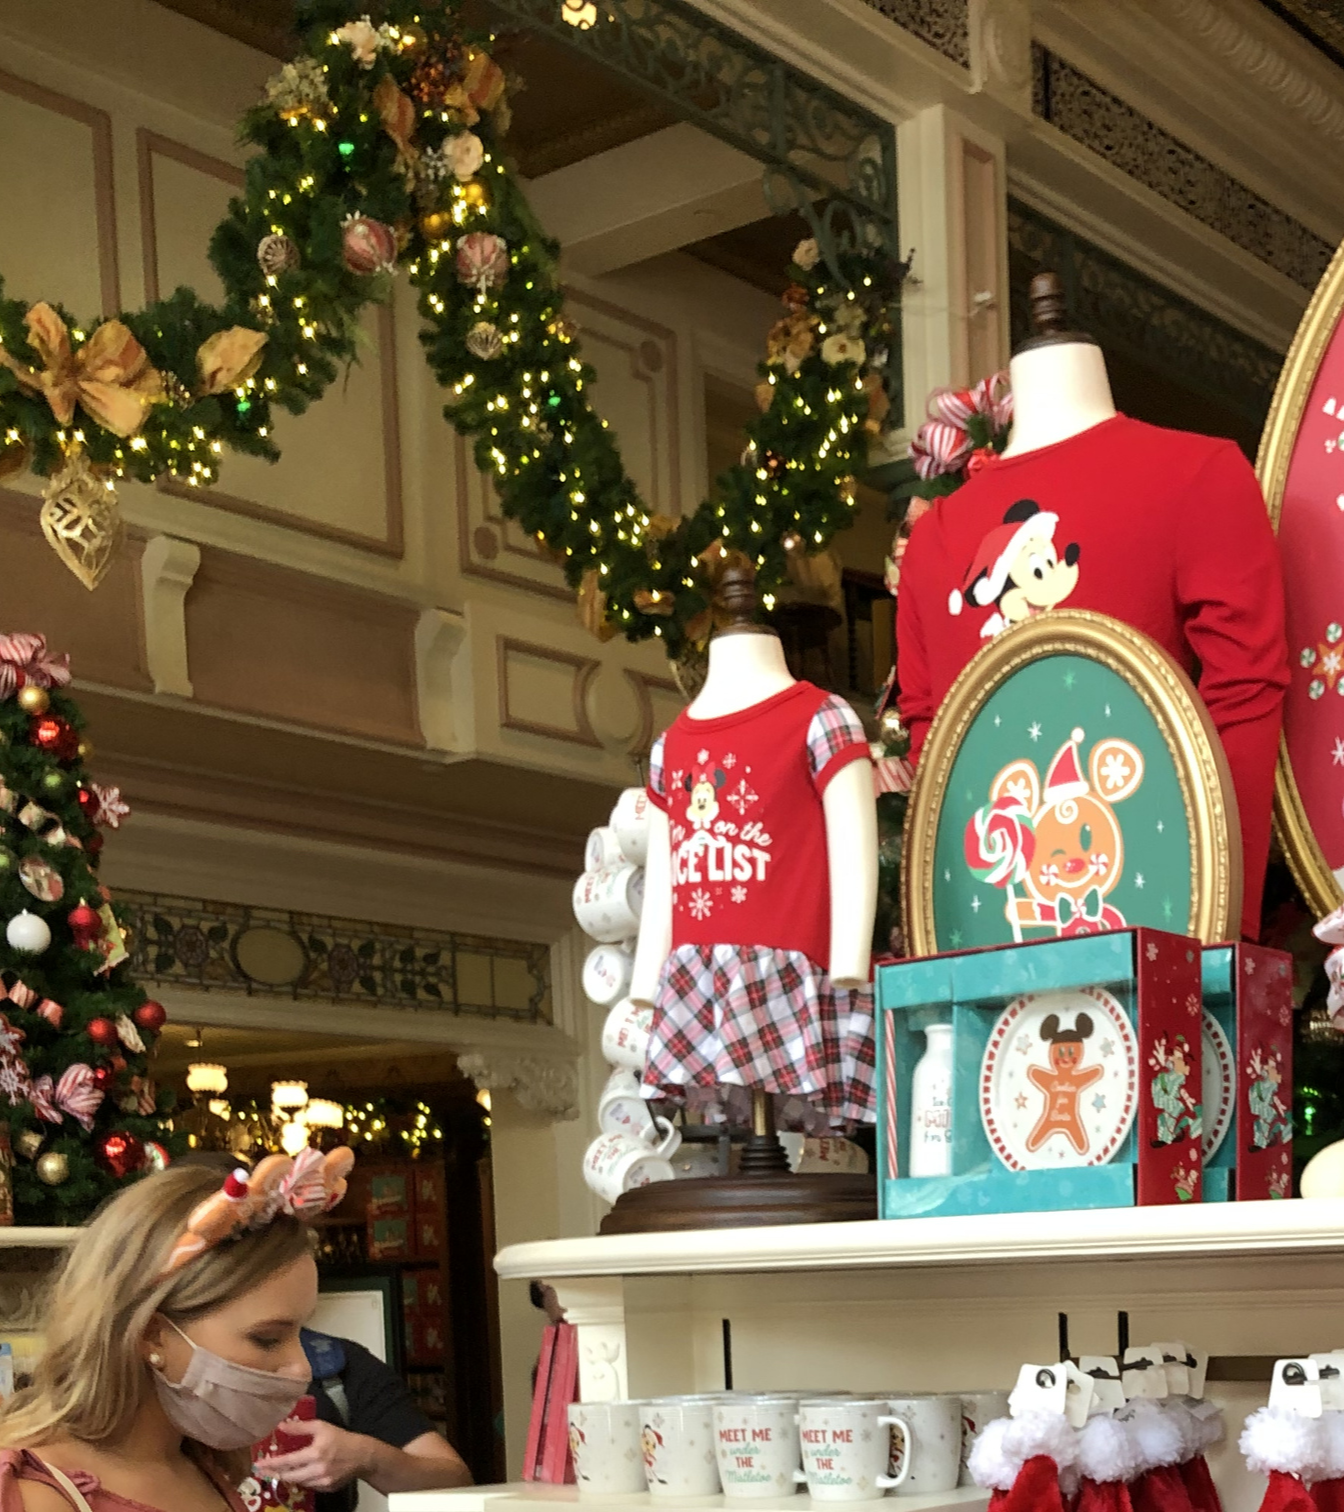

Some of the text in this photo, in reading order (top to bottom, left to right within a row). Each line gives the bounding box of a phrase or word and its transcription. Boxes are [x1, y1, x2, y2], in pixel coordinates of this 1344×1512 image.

[713, 820, 739, 837] on
[740, 821, 773, 847] the
[708, 842, 772, 882] LIST
[719, 1428, 772, 1443] MEET ME
[801, 1429, 854, 1444] MEET ME
[729, 1443, 760, 1457] under
[735, 1456, 755, 1469] THE
[815, 1458, 835, 1471] THE
